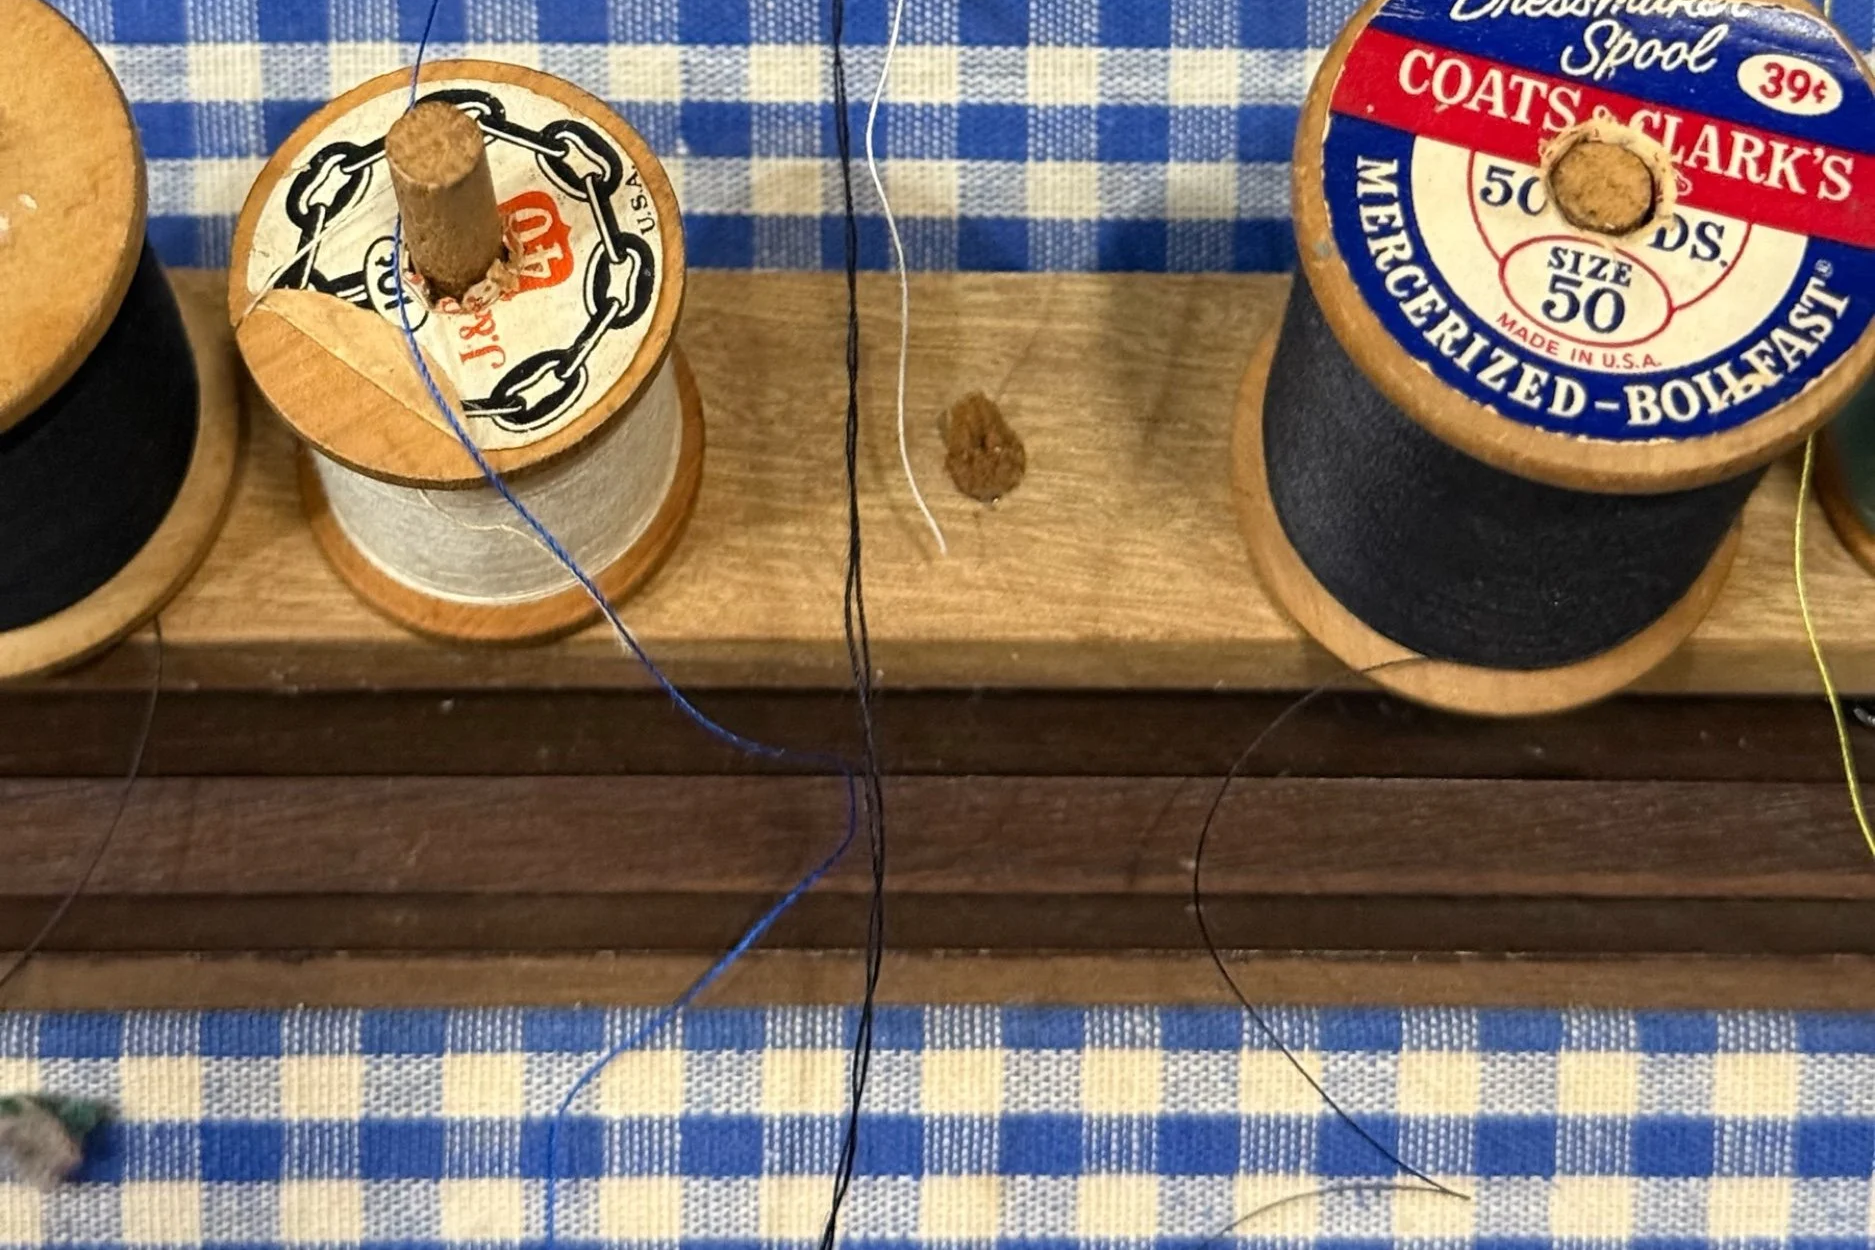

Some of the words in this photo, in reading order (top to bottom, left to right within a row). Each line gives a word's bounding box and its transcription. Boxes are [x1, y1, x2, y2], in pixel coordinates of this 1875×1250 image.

[1560, 19, 1730, 81] Spool
[1399, 48, 1582, 132] COATS
[1758, 61, 1829, 106] 39¢
[1547, 246, 1634, 288] SIZE
[1648, 212, 1729, 269] DS.
[1540, 277, 1627, 334] 50
[1495, 311, 1560, 357] MADE
[1570, 347, 1594, 366] IN
